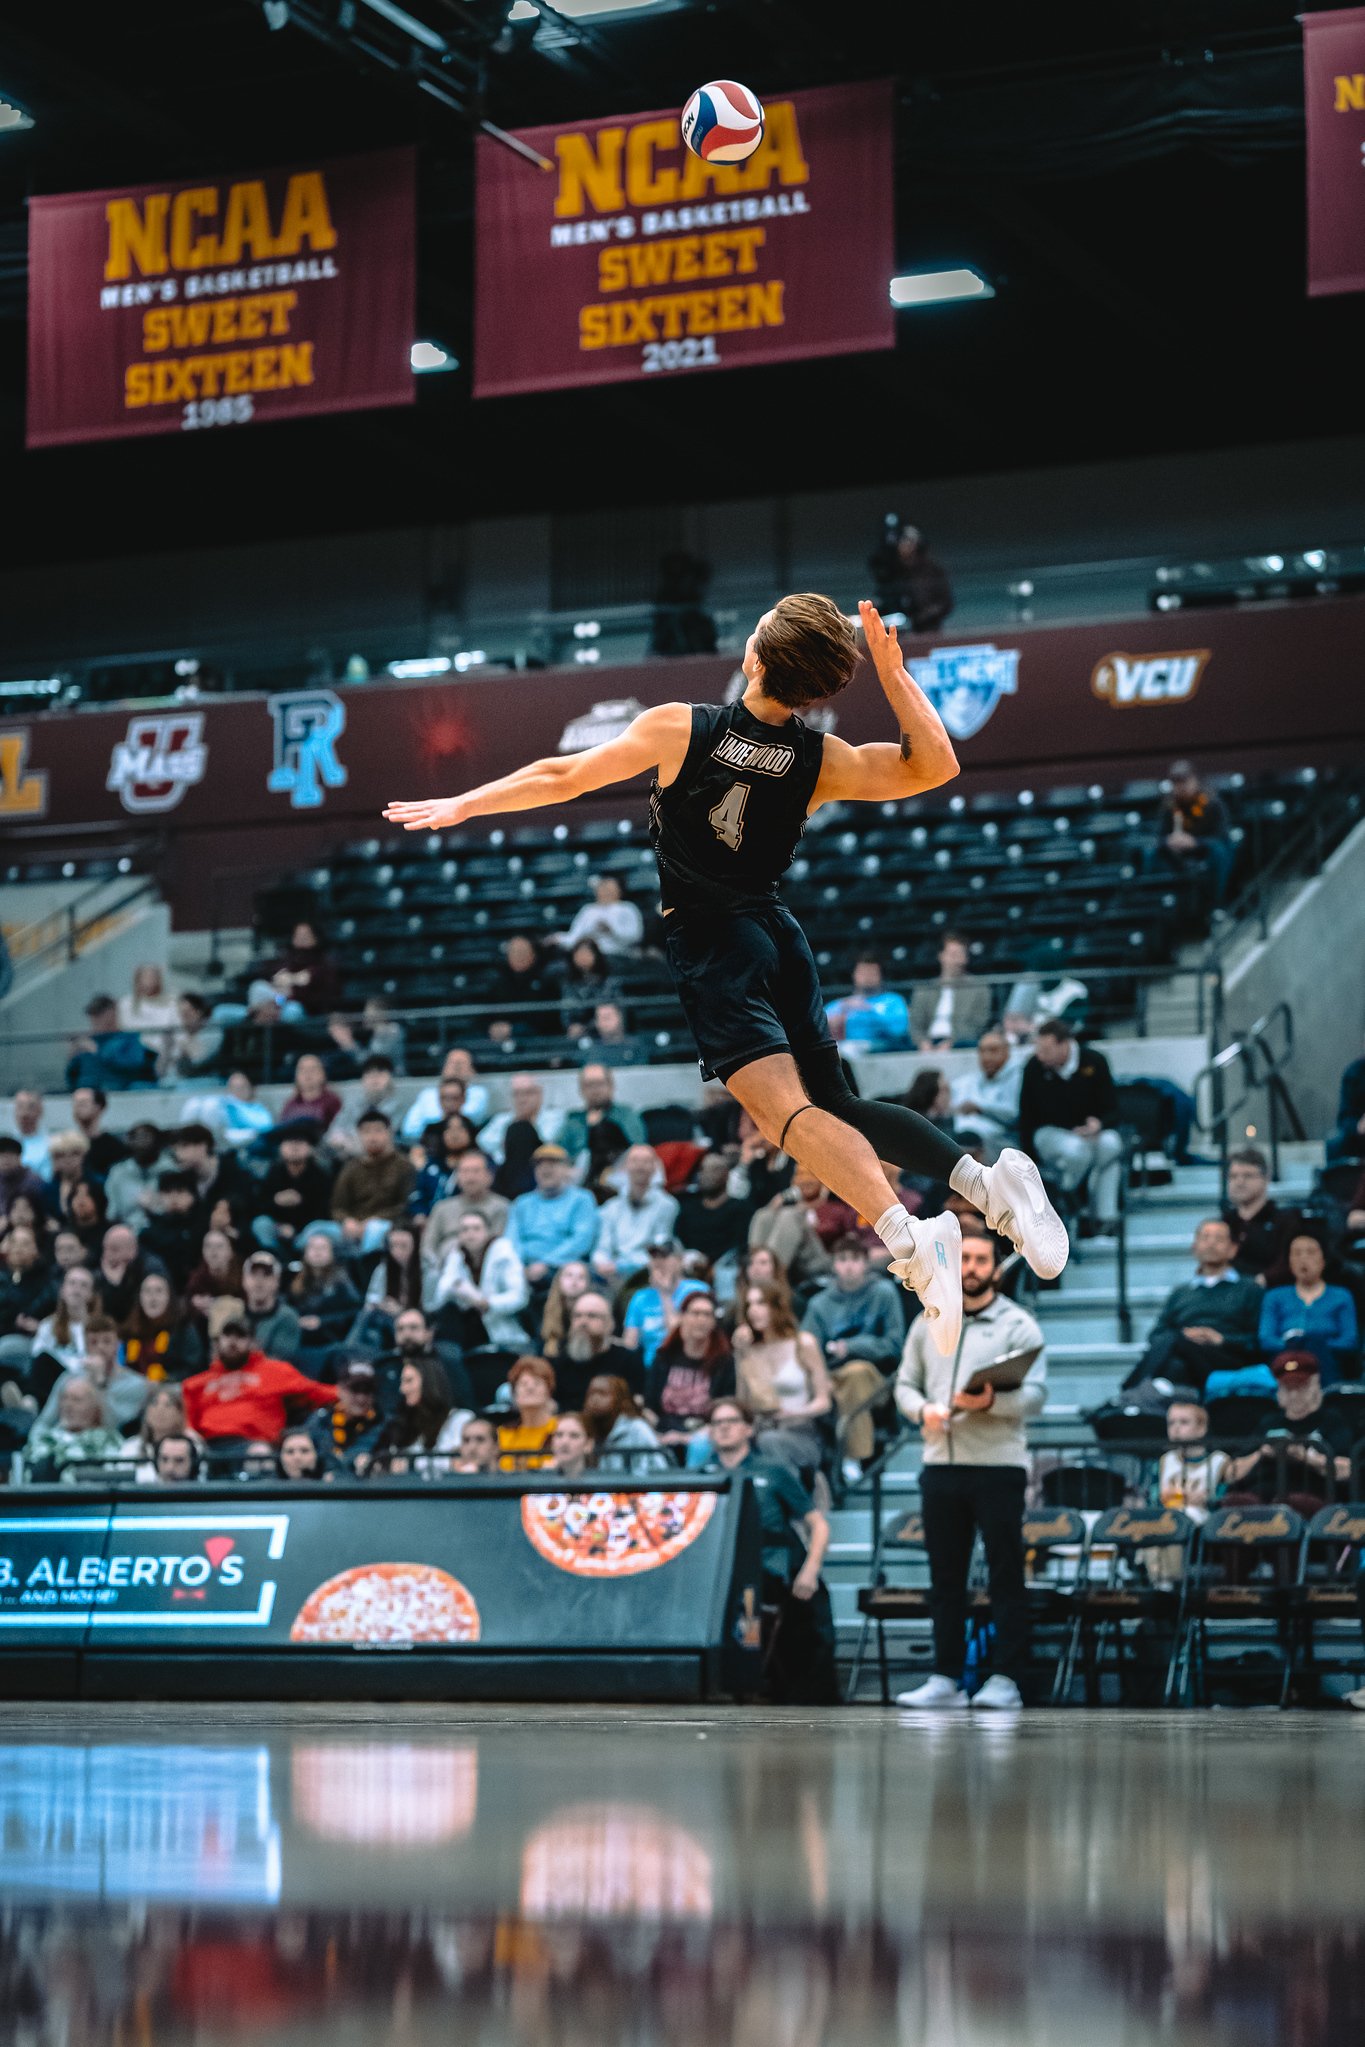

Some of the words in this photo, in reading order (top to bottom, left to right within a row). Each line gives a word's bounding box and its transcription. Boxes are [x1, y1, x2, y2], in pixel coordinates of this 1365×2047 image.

[104, 170, 337, 281] NCAA
[551, 215, 636, 248] MEN'S
[642, 191, 811, 236] BASKETBALL
[101, 278, 178, 310] MEN'S
[185, 256, 339, 299] BASKETBALL
[599, 227, 766, 293] SWEET
[143, 291, 298, 353] SWEET
[580, 280, 785, 350] SIXTEEN
[125, 341, 314, 409] SIXTEEN
[642, 335, 721, 373] 2021
[1111, 654, 1200, 703] VCU
[708, 781, 751, 851] 4
